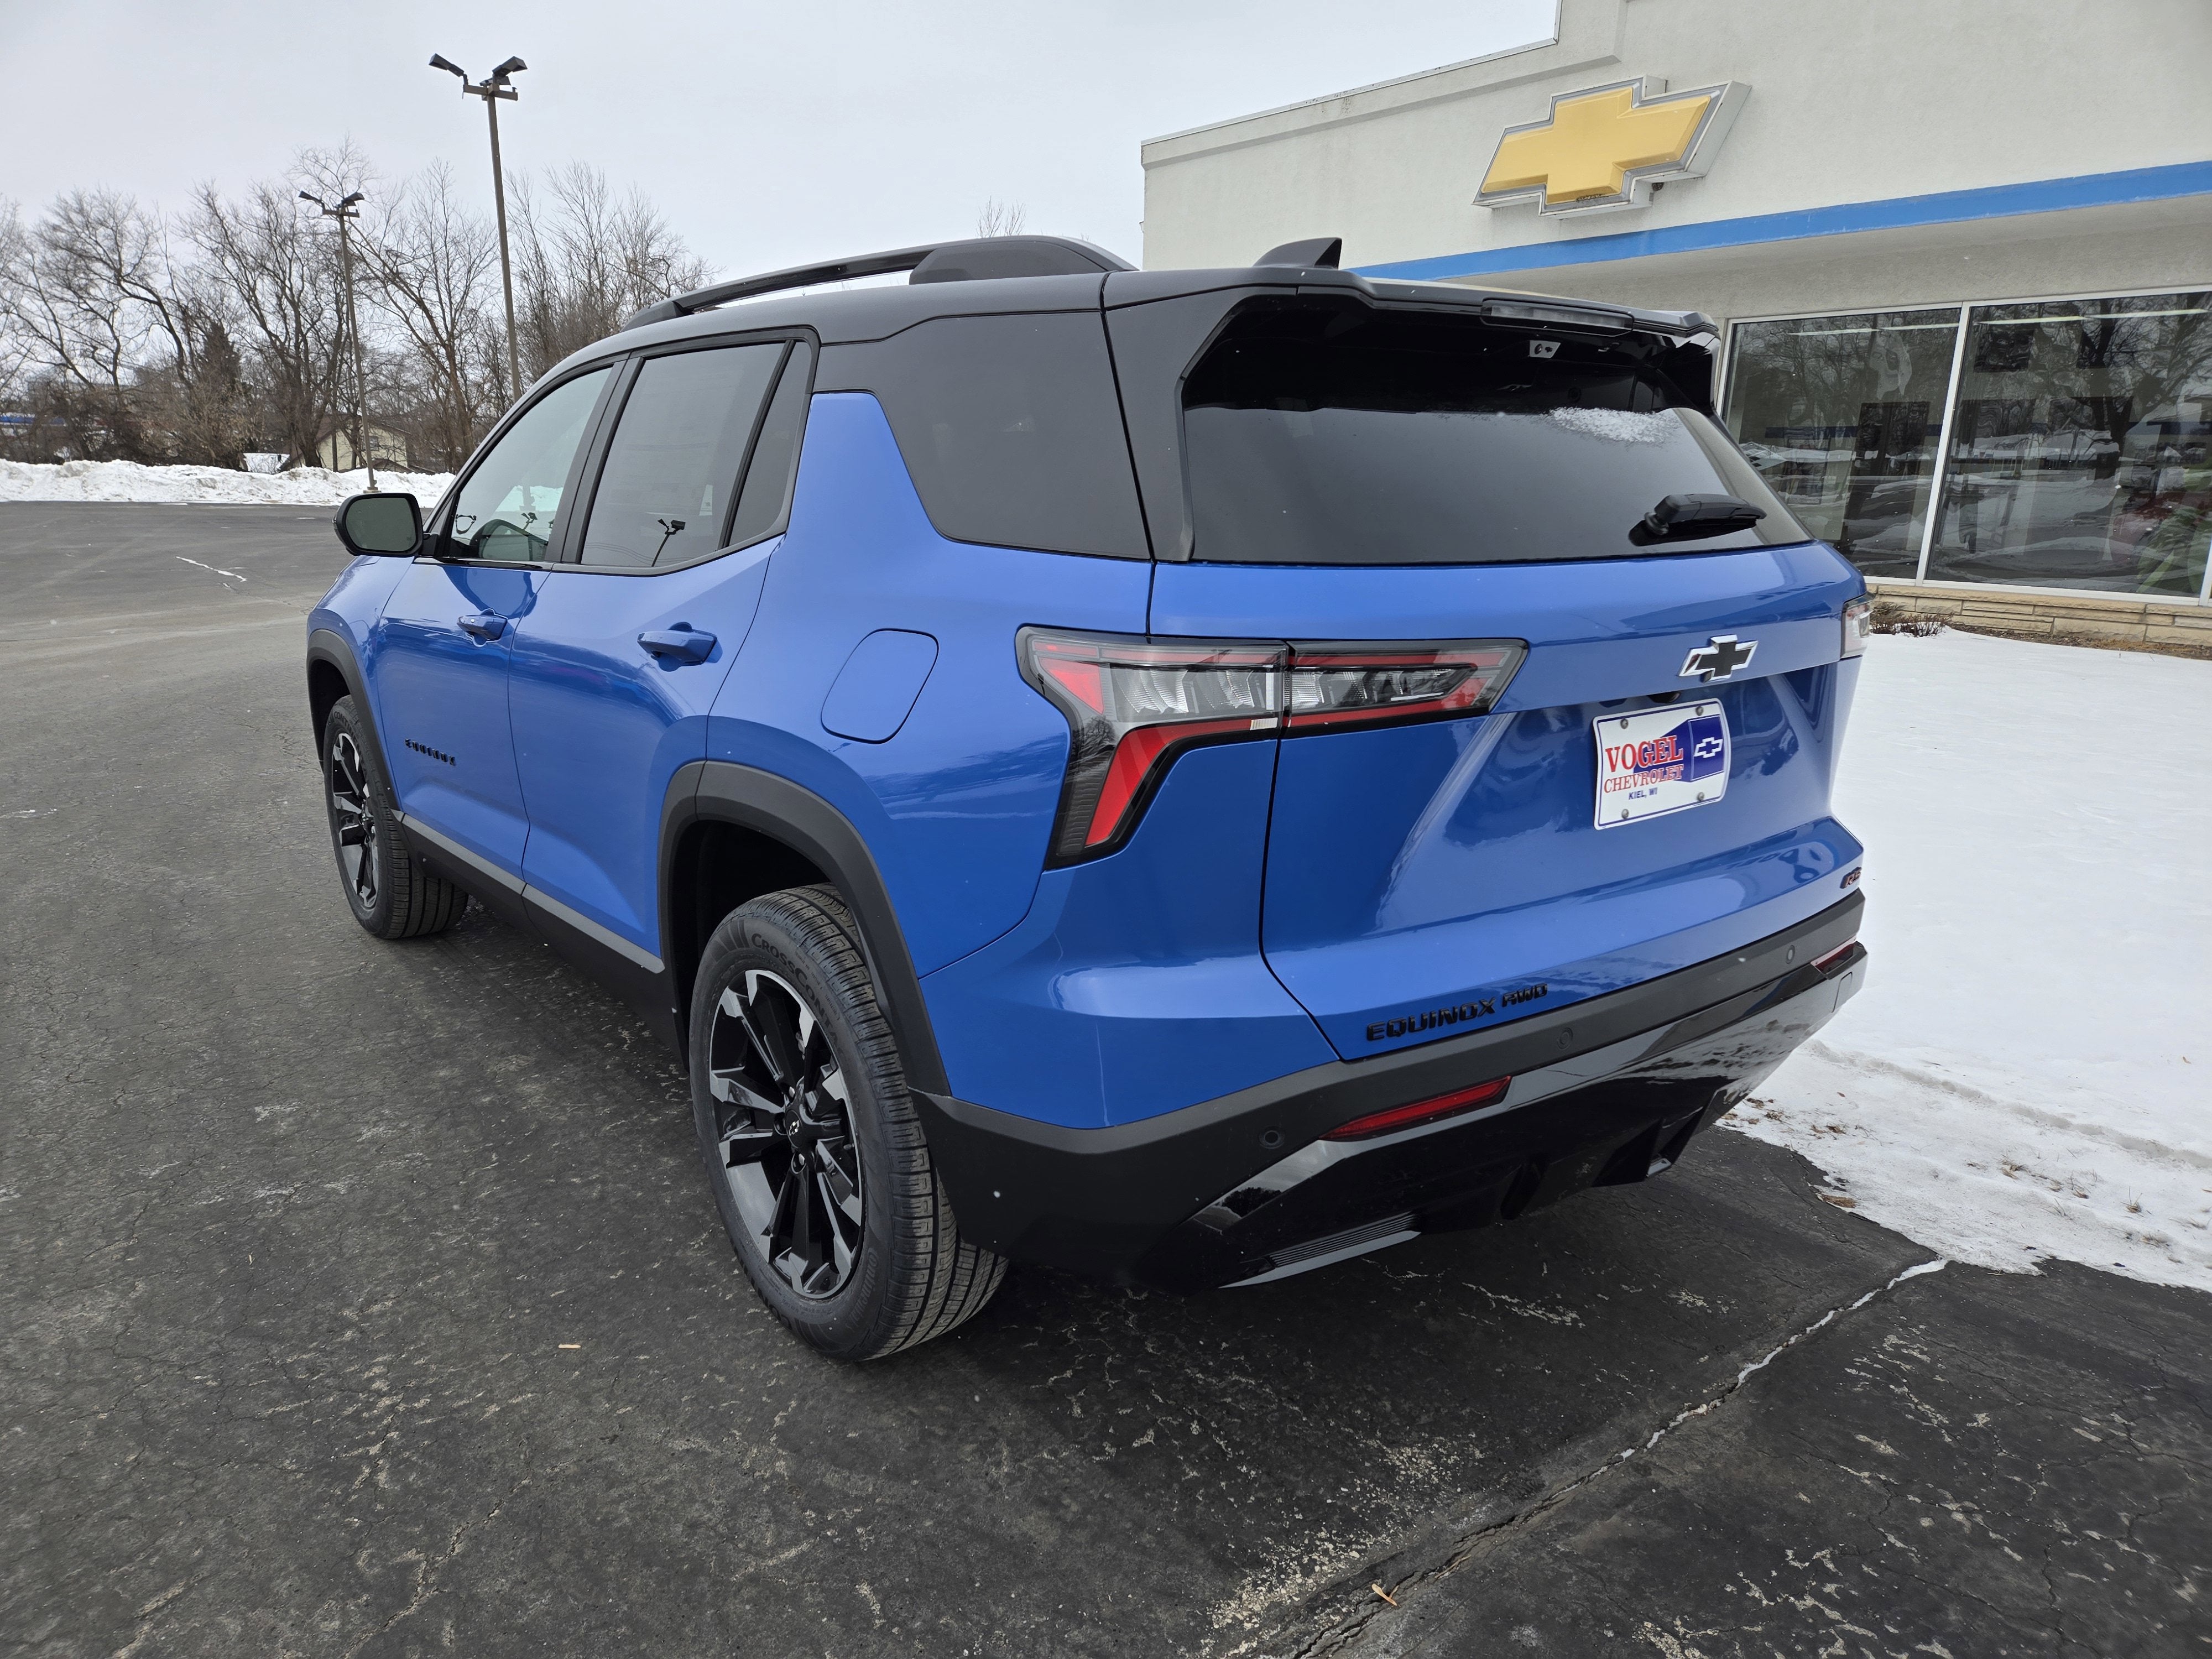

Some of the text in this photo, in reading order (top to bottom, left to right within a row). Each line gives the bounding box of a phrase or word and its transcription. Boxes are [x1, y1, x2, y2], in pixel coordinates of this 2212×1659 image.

[1605, 735, 1684, 773] VOGEL
[1604, 764, 1684, 793] CHEVROLET
[1628, 787, 1658, 800] KIEL, WI
[1366, 982, 1548, 1042] EQUINOX AWD
